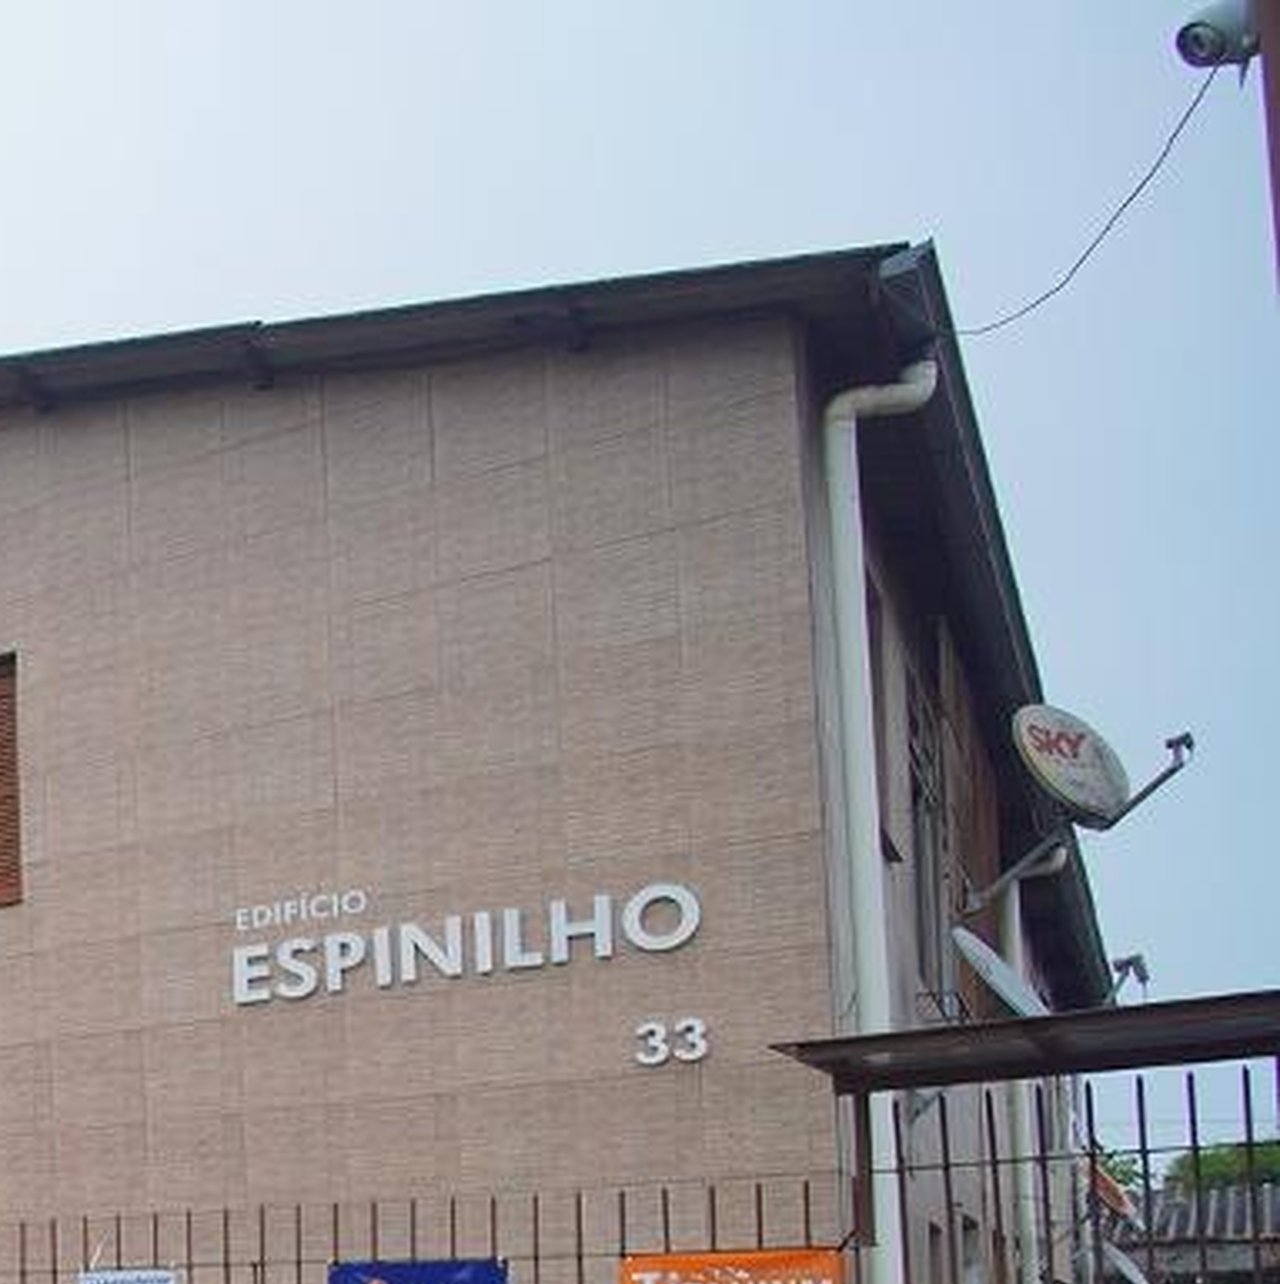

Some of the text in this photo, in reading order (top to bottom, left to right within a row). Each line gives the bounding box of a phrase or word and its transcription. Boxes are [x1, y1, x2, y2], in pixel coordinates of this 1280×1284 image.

[1026, 725, 1086, 759] SKY
[235, 890, 367, 931] EDIFÍCIO
[231, 883, 702, 1004] ESPINILHO
[635, 1017, 708, 1065] 33
